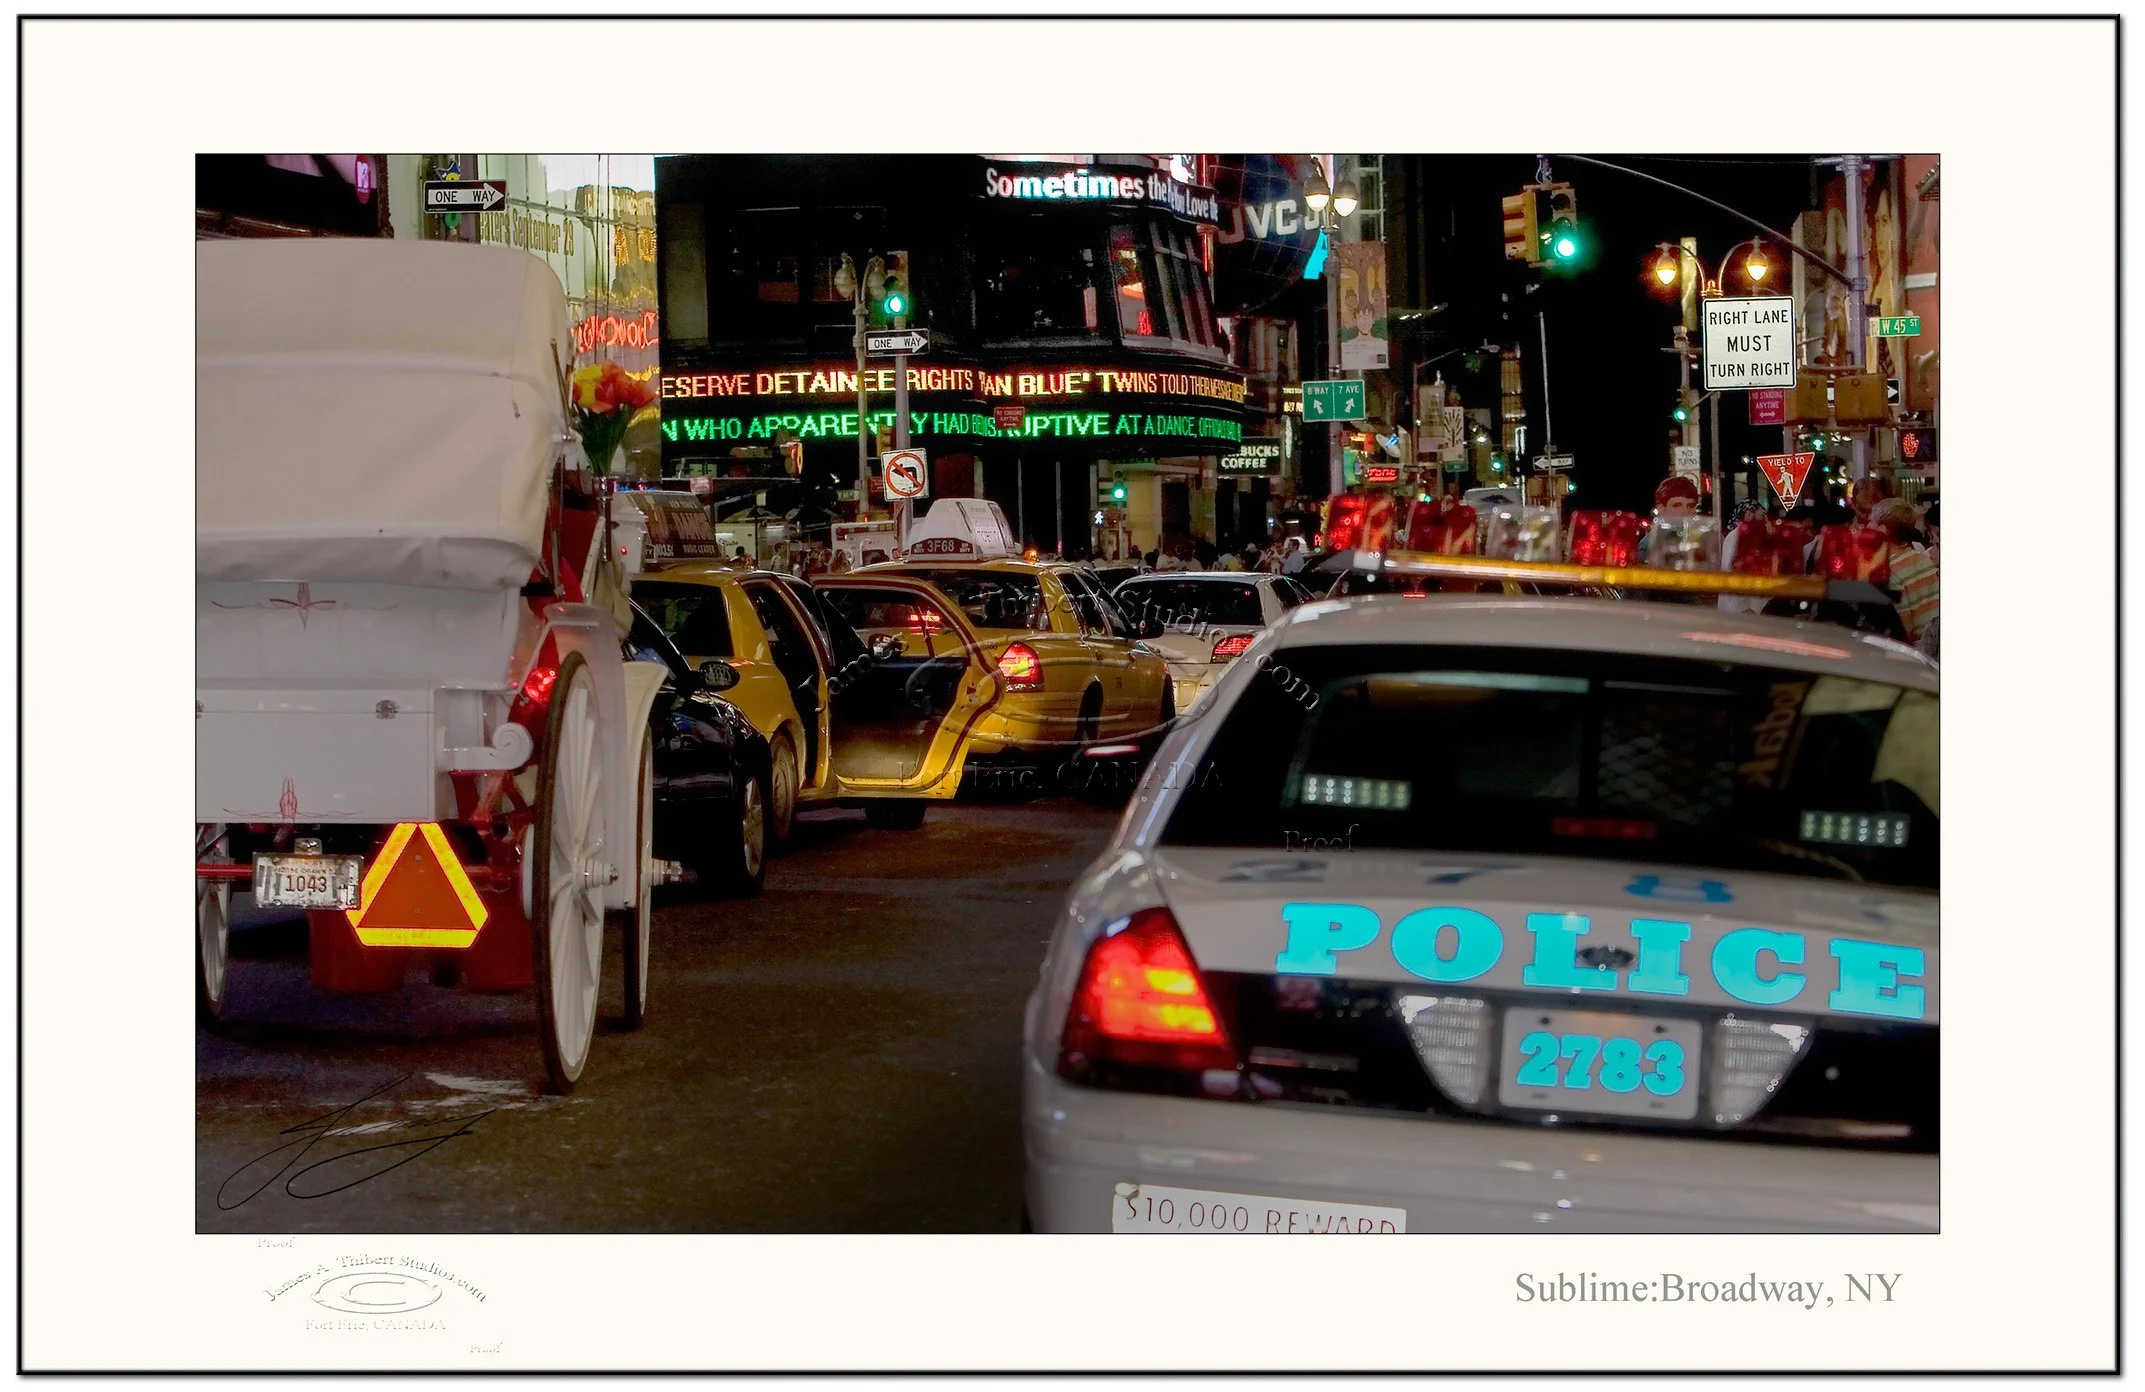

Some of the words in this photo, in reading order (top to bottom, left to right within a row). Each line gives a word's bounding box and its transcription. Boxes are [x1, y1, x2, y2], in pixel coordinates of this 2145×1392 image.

[435, 190, 458, 203] ONE
[472, 189, 496, 202] WAY
[986, 167, 1145, 199] Sometimes
[1147, 172, 1168, 203] the
[1186, 188, 1209, 219] Love
[1218, 199, 1298, 245] JVC
[512, 208, 560, 254] September
[1709, 310, 1749, 325] RIGHT
[1754, 309, 1789, 324] LANE
[1881, 319, 1890, 335] W
[1894, 319, 1906, 334] 45
[1909, 318, 1919, 327] ST
[874, 338, 892, 349] ONE
[904, 337, 922, 348] WAY
[1726, 335, 1772, 353] MUST
[1710, 363, 1745, 378] TURN
[1750, 361, 1790, 377] RIGHT
[661, 374, 751, 398] ESERVE
[756, 368, 896, 396] DETAINEE
[906, 368, 973, 392] RIGHTS
[1095, 371, 1157, 394] TWINS
[1159, 373, 1188, 396] TOLD
[1338, 385, 1343, 394] 7
[1345, 384, 1360, 394] AVE
[1751, 391, 1759, 399] NO
[1760, 390, 1783, 400] STANDING
[1755, 401, 1780, 410] ANYTIME
[684, 417, 742, 440] WHO
[748, 412, 928, 438] APPARENTY
[933, 413, 969, 434] HAD
[1115, 413, 1143, 436] AT
[1144, 415, 1156, 435] A
[1220, 456, 1267, 469] COFFEE
[1767, 458, 1792, 467] YIELD
[1794, 456, 1805, 465] TO
[927, 539, 955, 552] 3F68
[286, 875, 328, 893] 1043
[1276, 901, 1926, 1020] POLICE
[1516, 1031, 1686, 1096] 2783
